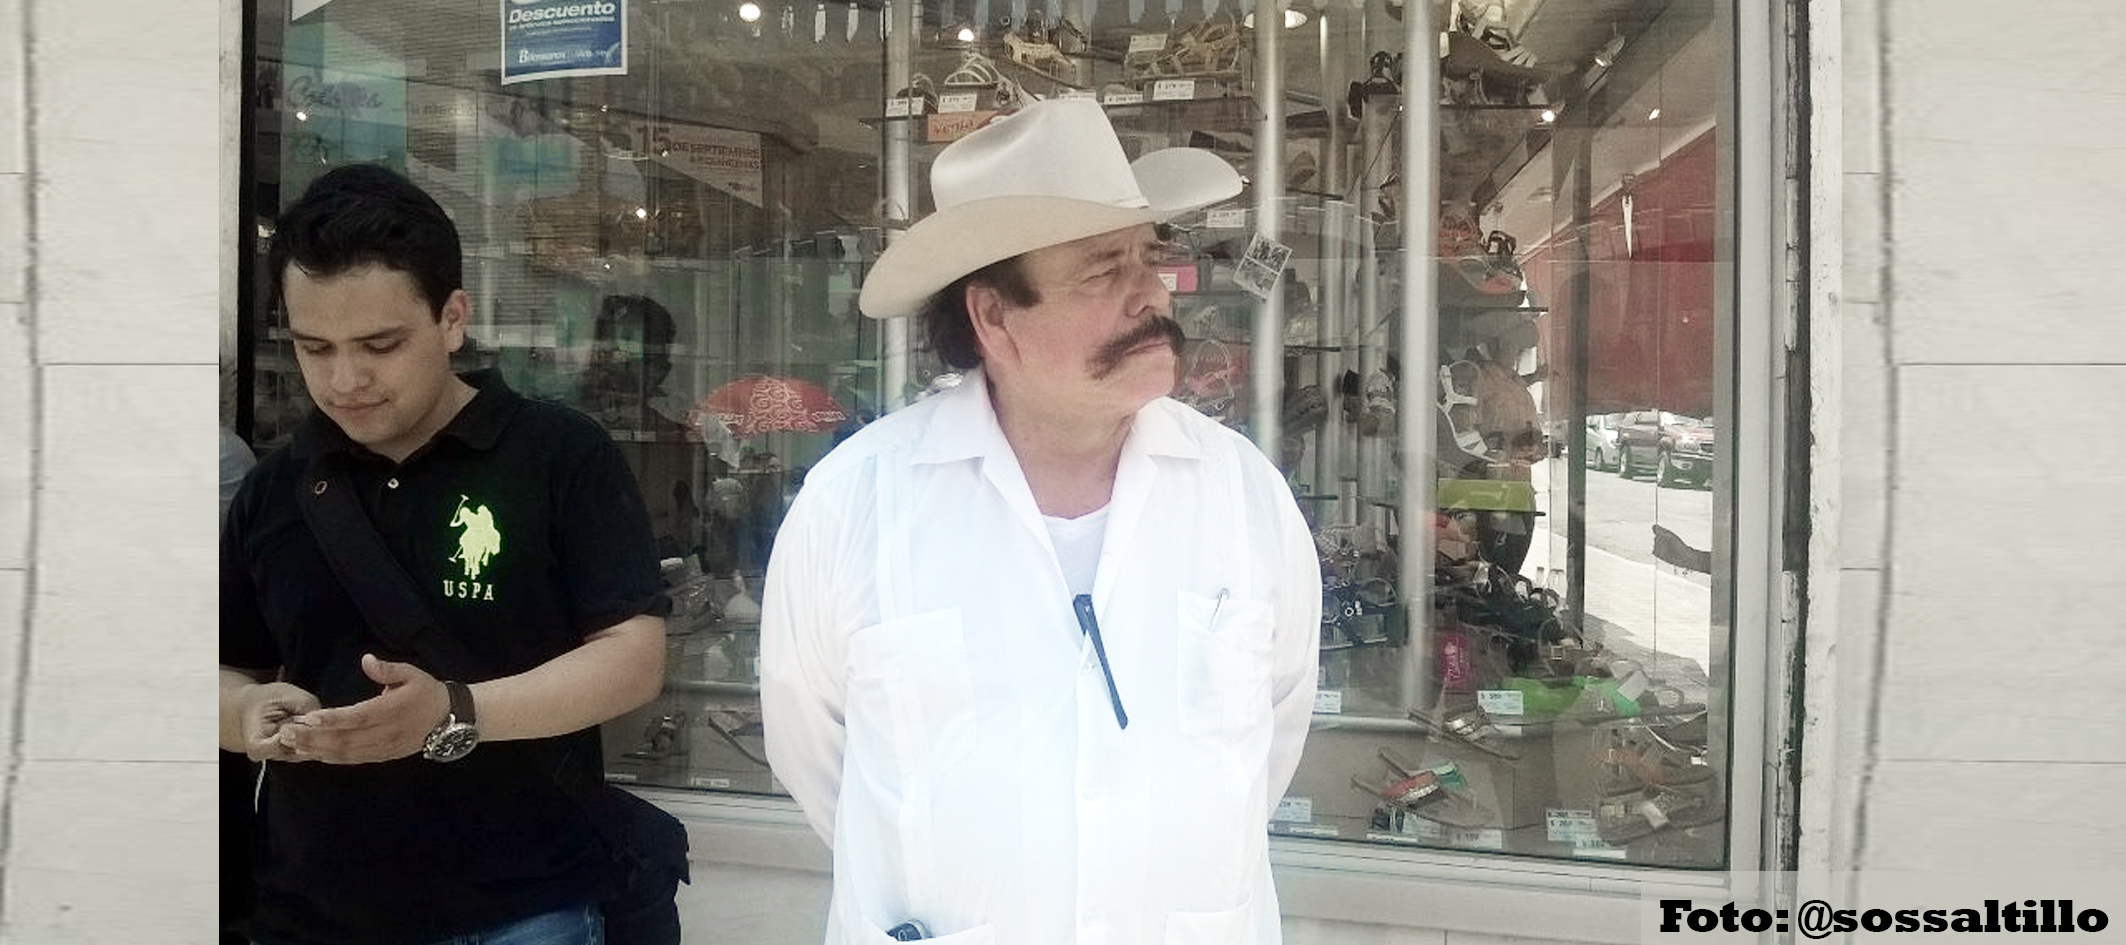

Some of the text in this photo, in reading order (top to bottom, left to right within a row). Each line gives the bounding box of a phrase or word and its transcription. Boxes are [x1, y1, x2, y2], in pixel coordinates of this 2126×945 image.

[509, 1, 616, 23] Descuento
[637, 125, 672, 158] 15
[672, 142, 760, 159] DE SEPTIEMBRE
[443, 580, 494, 601] USPA
